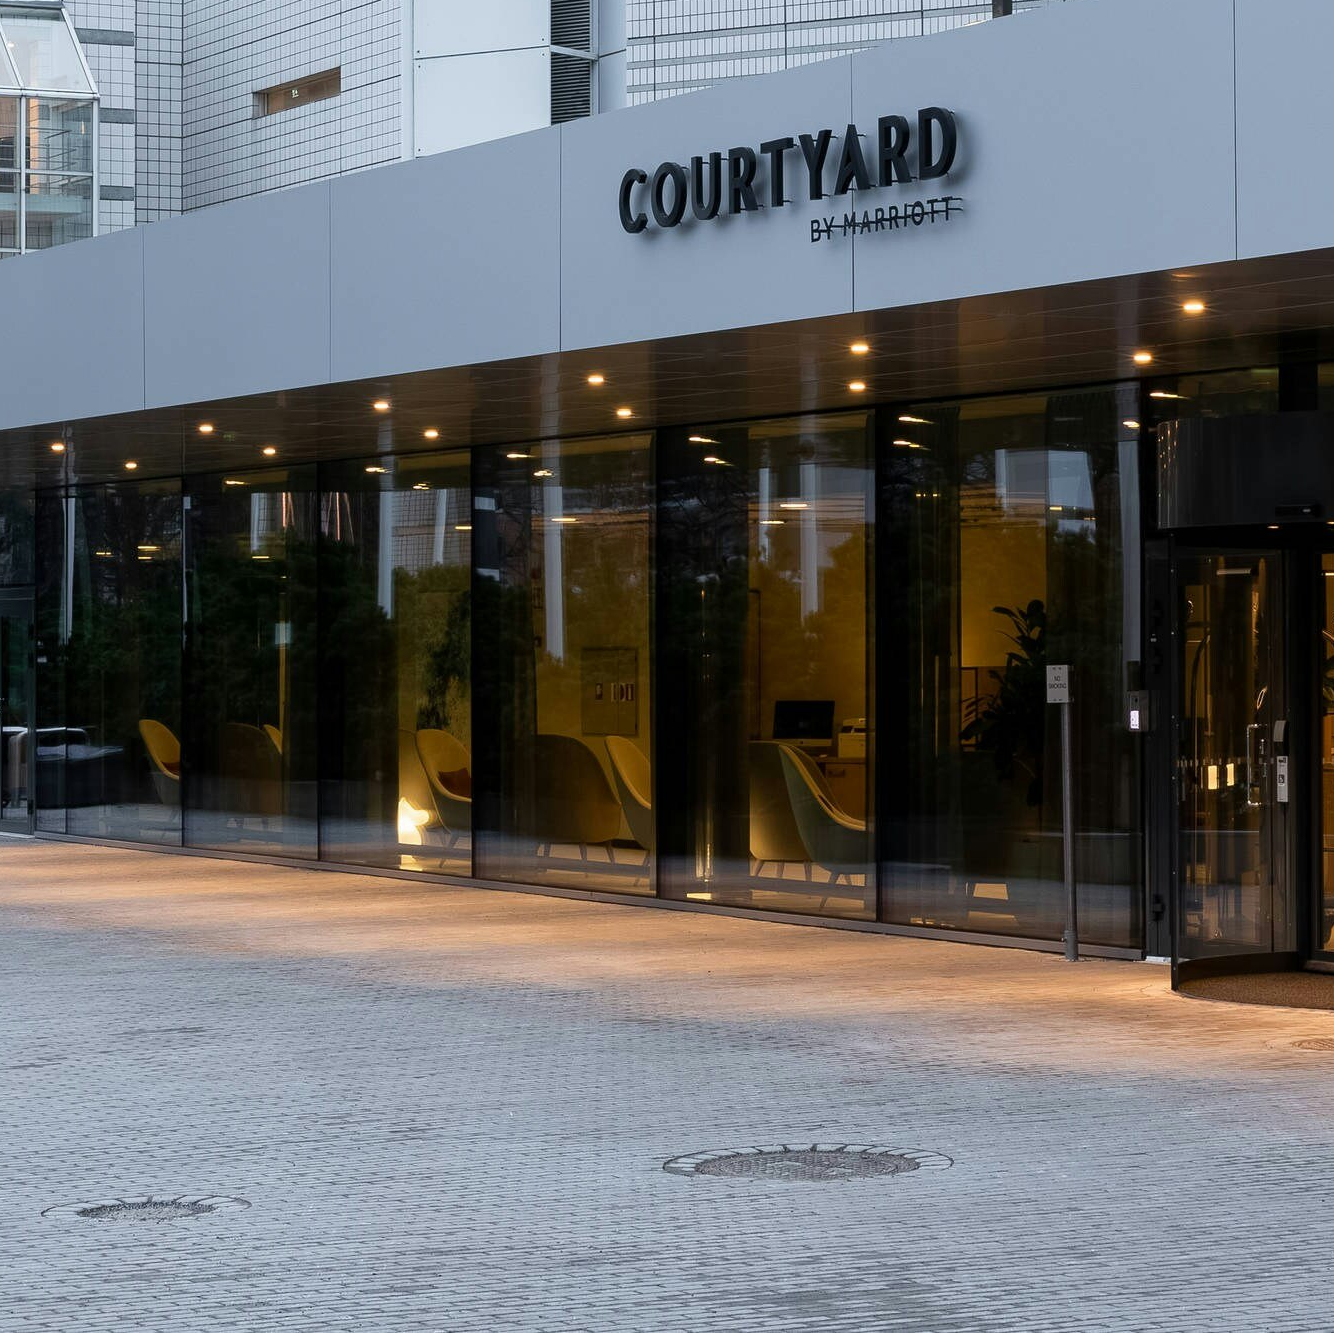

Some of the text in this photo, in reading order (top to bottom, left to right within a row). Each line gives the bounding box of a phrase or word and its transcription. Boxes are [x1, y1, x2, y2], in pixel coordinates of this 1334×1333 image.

[619, 107, 957, 233] COURTYARD
[810, 196, 954, 243] BY MARRIOTT
